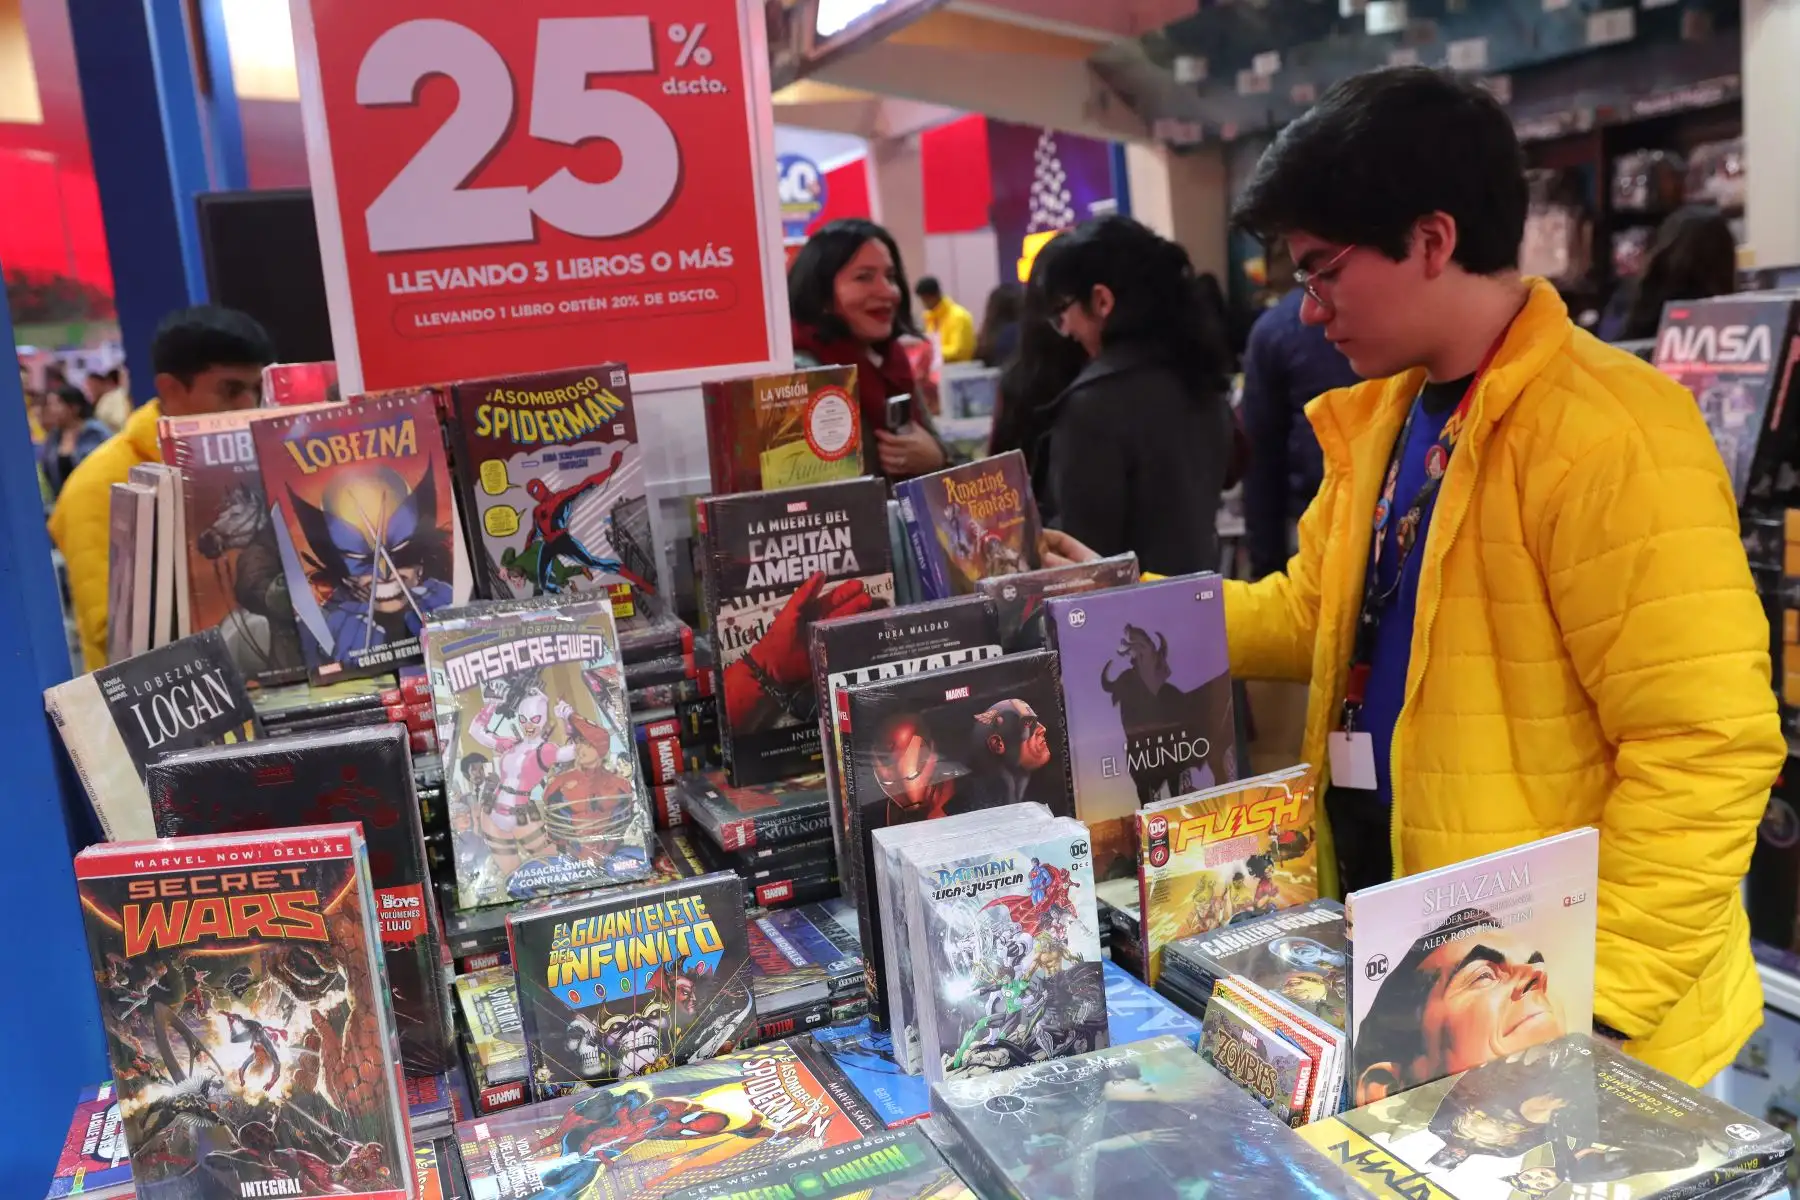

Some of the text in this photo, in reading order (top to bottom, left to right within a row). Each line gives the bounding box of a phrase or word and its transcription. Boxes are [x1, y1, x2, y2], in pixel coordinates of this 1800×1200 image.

[667, 23, 713, 67] %
[661, 74, 727, 96] dscto.
[355, 16, 680, 253] 25
[387, 242, 734, 295] LLEVANDO 3 LIBROS O MÁS
[414, 288, 720, 328] LLEVANDO 1 LIBRO OBTÉN 20% DE DSCTO.
[1660, 325, 1771, 362] NASA
[493, 376, 600, 407] ASOMBROSO
[760, 383, 809, 402] LA VISIÓN
[475, 388, 627, 444] SPIDERMAN
[284, 419, 418, 475] LOBEZNA
[943, 471, 1007, 503] Amazing
[967, 489, 1021, 520] Fantasy
[748, 510, 850, 535] LA MUERTE DEL
[749, 526, 852, 562] CAPITÁN
[745, 550, 861, 589] AMÉRICA
[878, 620, 950, 640] PURA MALDAD
[1069, 610, 1086, 626] DC
[358, 652, 393, 668] CUATRO
[445, 634, 605, 691] MASACRE-GWEN
[130, 668, 237, 750] LOGAN
[945, 686, 970, 700] MARVEL
[1102, 737, 1210, 779] EL MUNDO
[1149, 819, 1167, 835] DC
[1174, 789, 1305, 856] FLASH
[135, 843, 345, 869] MARVEL NOW! DELUXE
[1070, 842, 1089, 857] DC
[128, 867, 308, 899] SECRET
[933, 857, 1016, 889] BATMAN
[935, 873, 1024, 901] LIGA JUSTICIA
[1422, 862, 1532, 915] SHAZAM
[383, 896, 420, 909] BOYS
[570, 894, 711, 943] GUANTELETE
[123, 890, 329, 958] WARS
[386, 920, 412, 932] LUJO
[553, 923, 569, 938] EL
[1423, 933, 1448, 951] ALEX
[1450, 928, 1477, 942] ROSS
[548, 920, 725, 988] INFINITO
[549, 950, 573, 965] DEL
[1366, 958, 1388, 977] DC
[1242, 1029, 1259, 1049] MARVEL
[1212, 1029, 1279, 1100] ZOMBIES
[487, 1088, 521, 1106] MARVEL
[742, 1057, 831, 1138] SPIDERMAN
[780, 1063, 830, 1115] ASOMBROSO
[1293, 1067, 1312, 1107] MARVEL
[1597, 1071, 1663, 1107] COMPROMISO
[1599, 1082, 1638, 1104] REGLAS
[828, 1081, 874, 1132] MARVEL SAGA
[1637, 1102, 1660, 1115] LAS
[1663, 1105, 1684, 1118] DEL
[516, 1138, 532, 1157] VIDA
[688, 1184, 720, 1197] LEN
[727, 1170, 769, 1185] WEIN
[787, 1153, 829, 1169] DAVE
[821, 1143, 912, 1188] LANTERN
[240, 1178, 303, 1198] INTEGRAL
